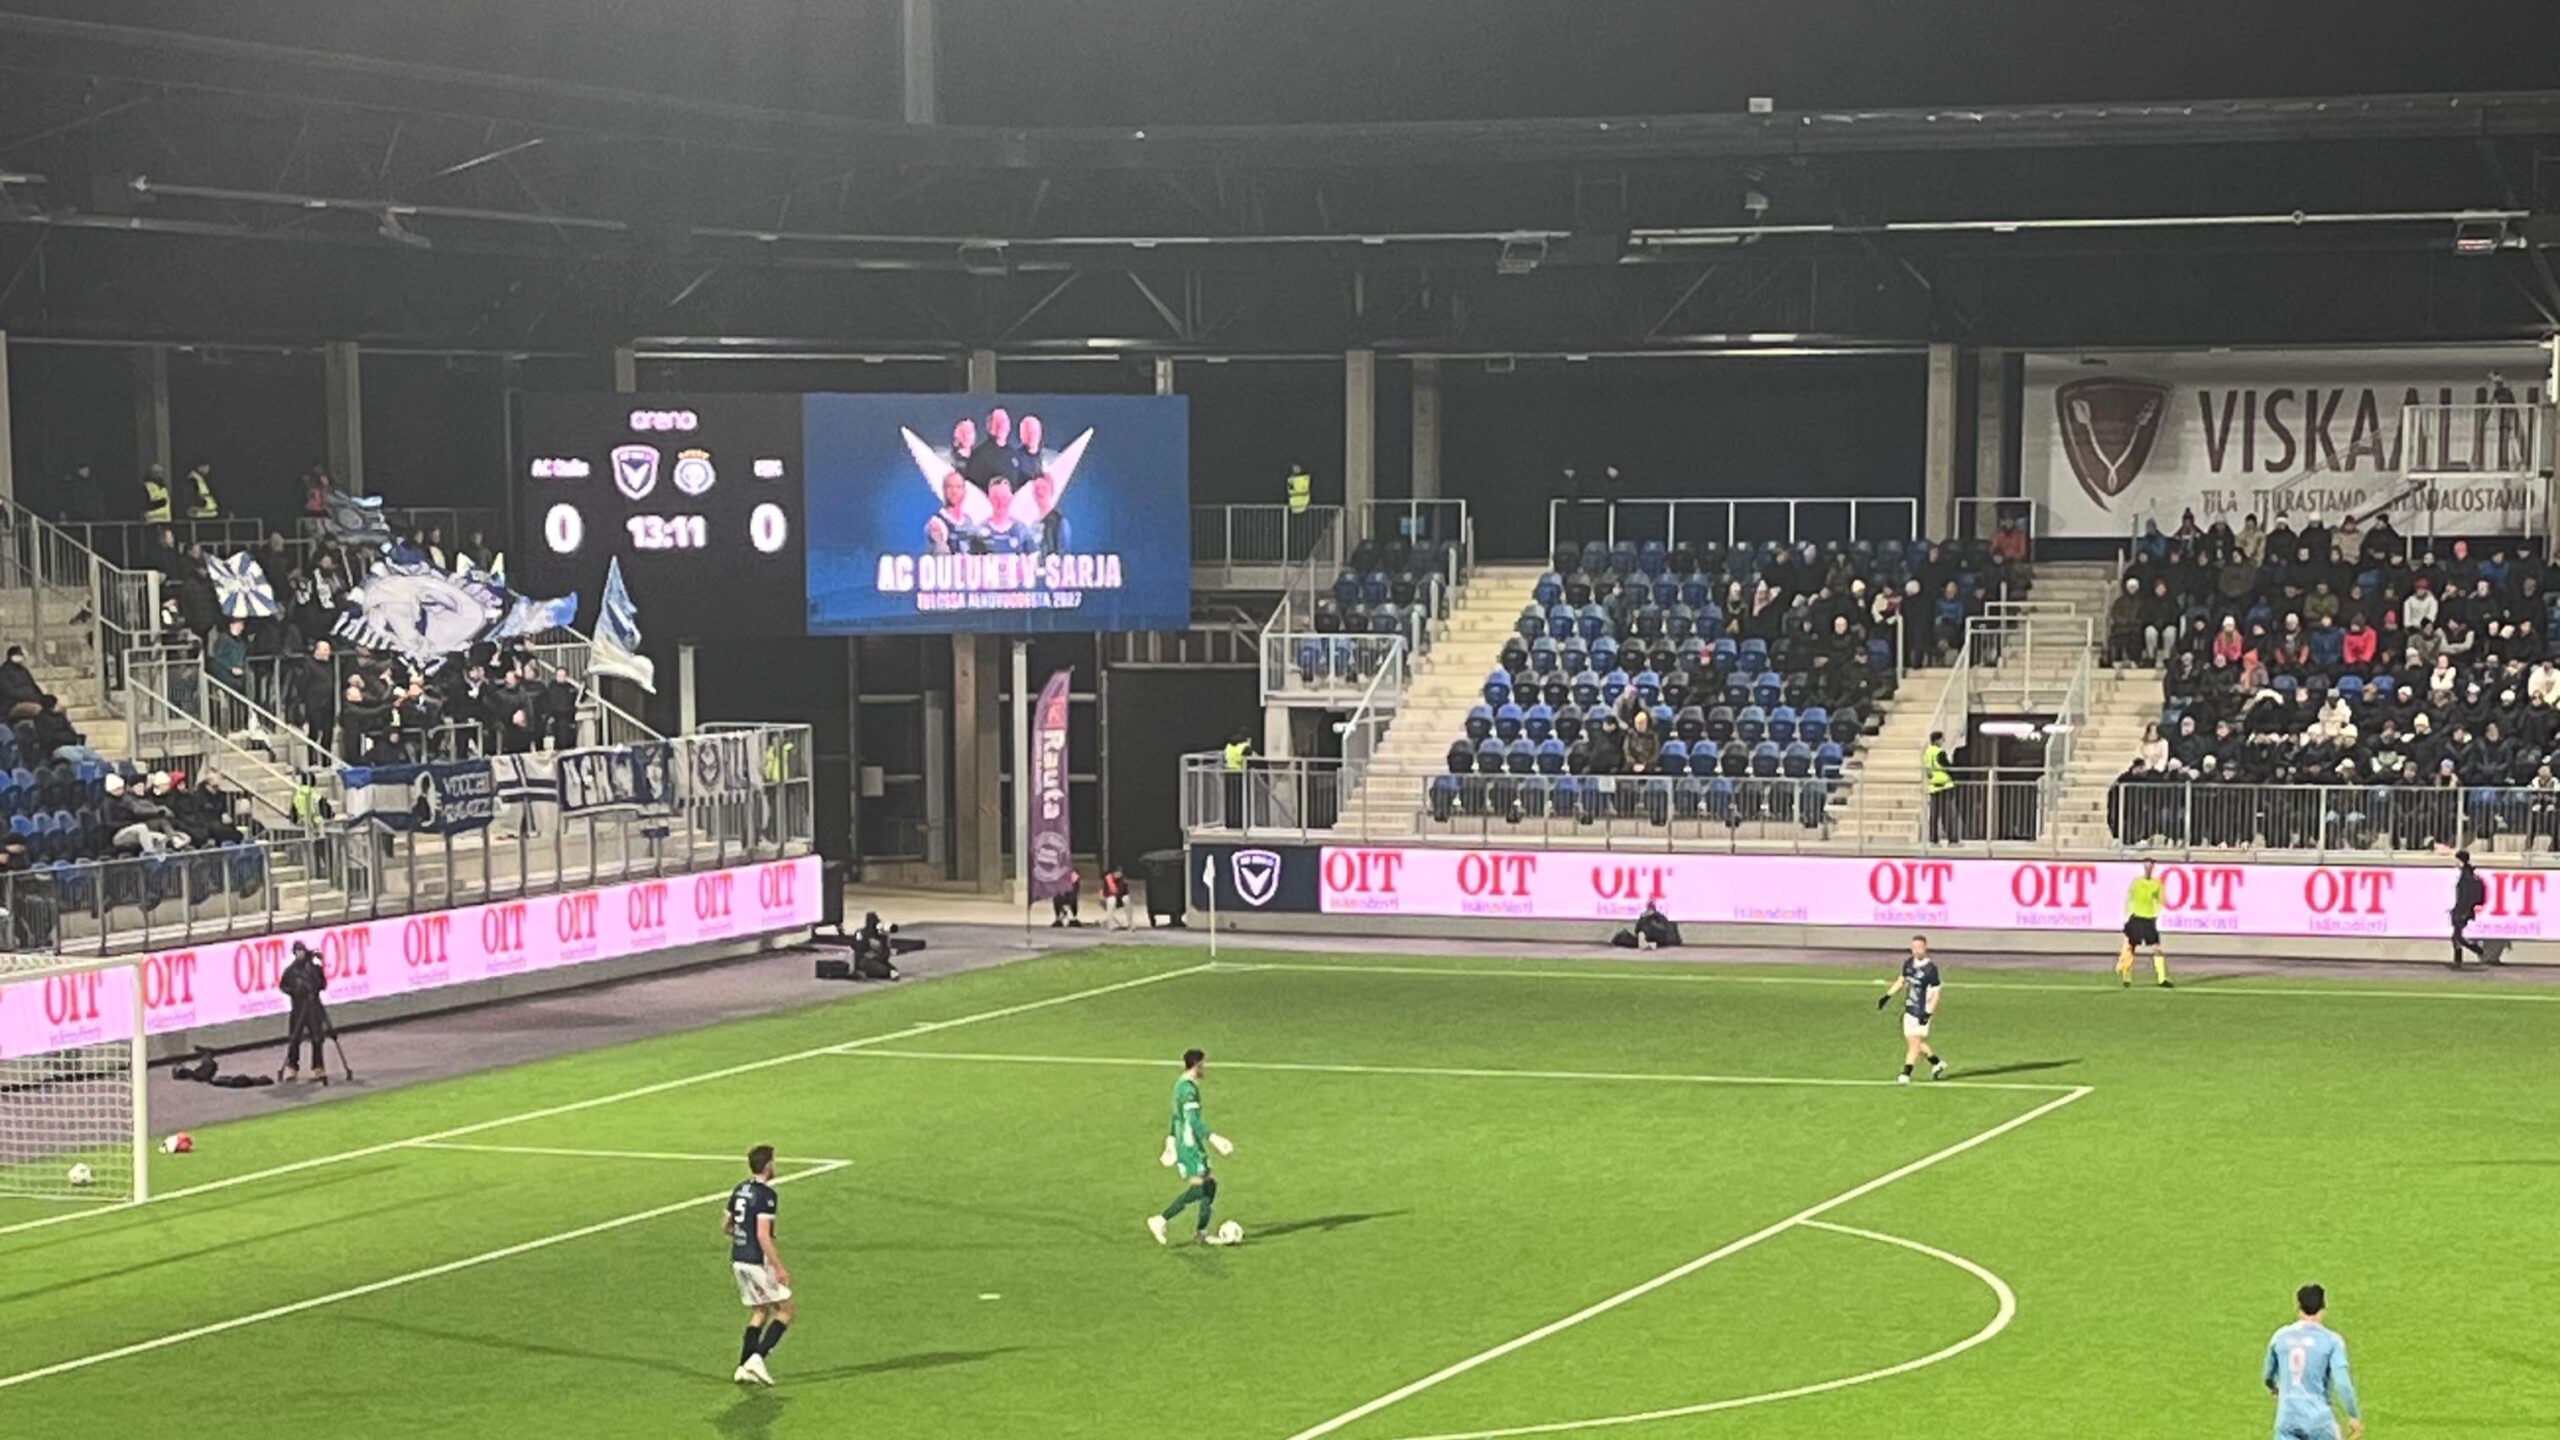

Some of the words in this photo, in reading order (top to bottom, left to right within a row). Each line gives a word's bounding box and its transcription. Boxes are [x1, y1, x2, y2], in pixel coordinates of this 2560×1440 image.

[545, 503, 582, 553] 0
[626, 515, 706, 548] 13:11
[750, 503, 787, 553] 0
[877, 555, 914, 591] AC
[918, 554, 1000, 591] OULUN
[759, 863, 796, 910] OIT
[1325, 851, 1403, 893] OIT
[1457, 853, 1537, 896] OIT
[1869, 860, 1953, 905] OIT
[2011, 864, 2097, 908] OIT
[2160, 866, 2243, 911] OIT
[2305, 868, 2393, 914] OIT
[2474, 873, 2545, 916] IT
[557, 893, 599, 943] OIT
[628, 882, 668, 931] OIT
[695, 872, 733, 920] OIT
[403, 915, 450, 967] OIT
[482, 904, 527, 954] OIT
[234, 939, 286, 994] OIT
[321, 926, 371, 981] OIT
[45, 971, 103, 1025] OIT
[143, 952, 198, 1009] OIT
[734, 1198, 747, 1223] 5
